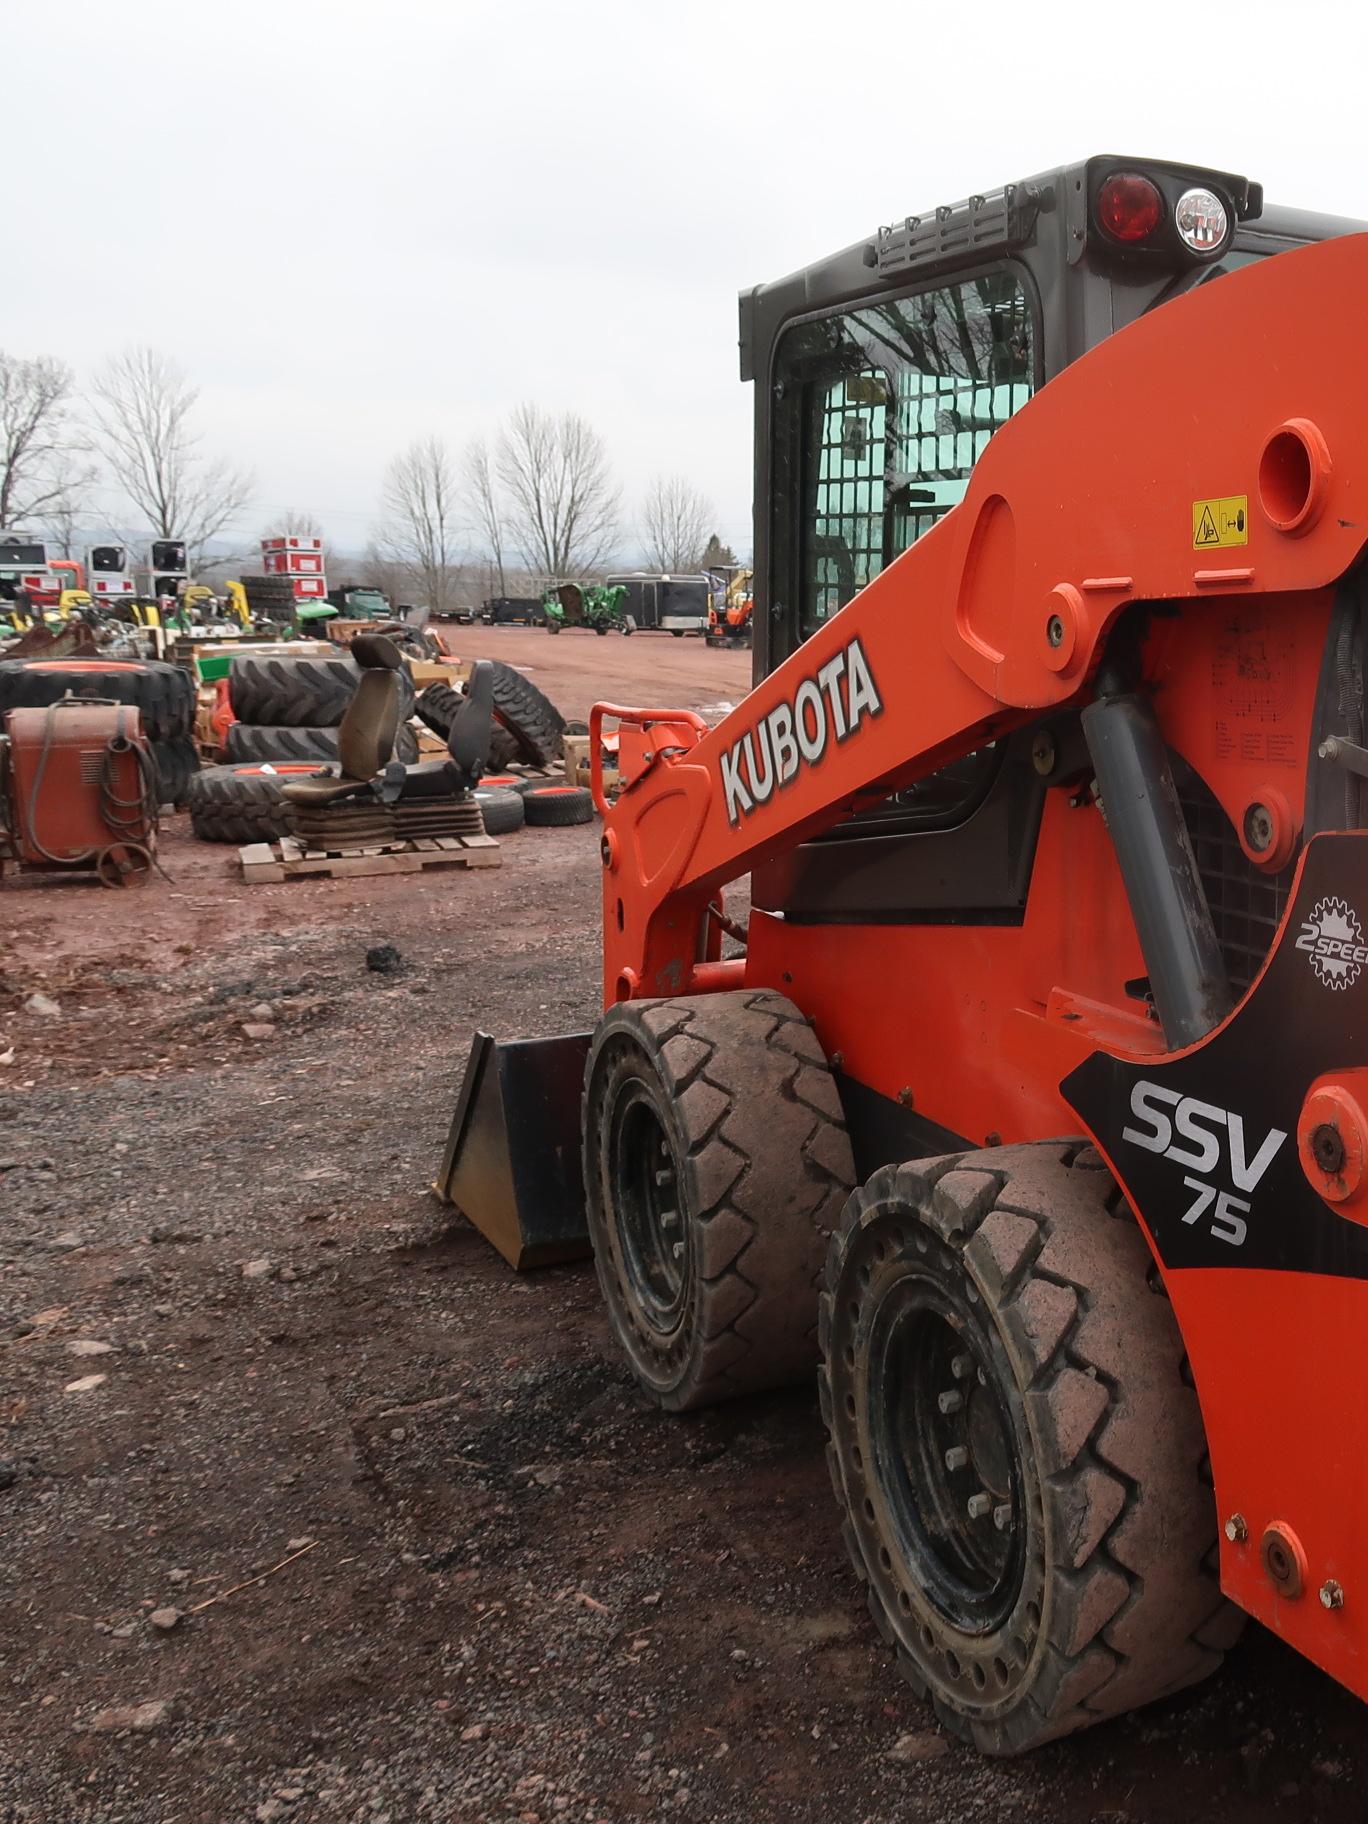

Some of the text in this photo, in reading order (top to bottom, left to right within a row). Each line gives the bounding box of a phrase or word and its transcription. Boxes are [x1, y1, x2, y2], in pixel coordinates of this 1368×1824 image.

[720, 639, 881, 824] KUBOTA
[1122, 1080, 1288, 1193] SSV
[1181, 1175, 1251, 1247] 75
